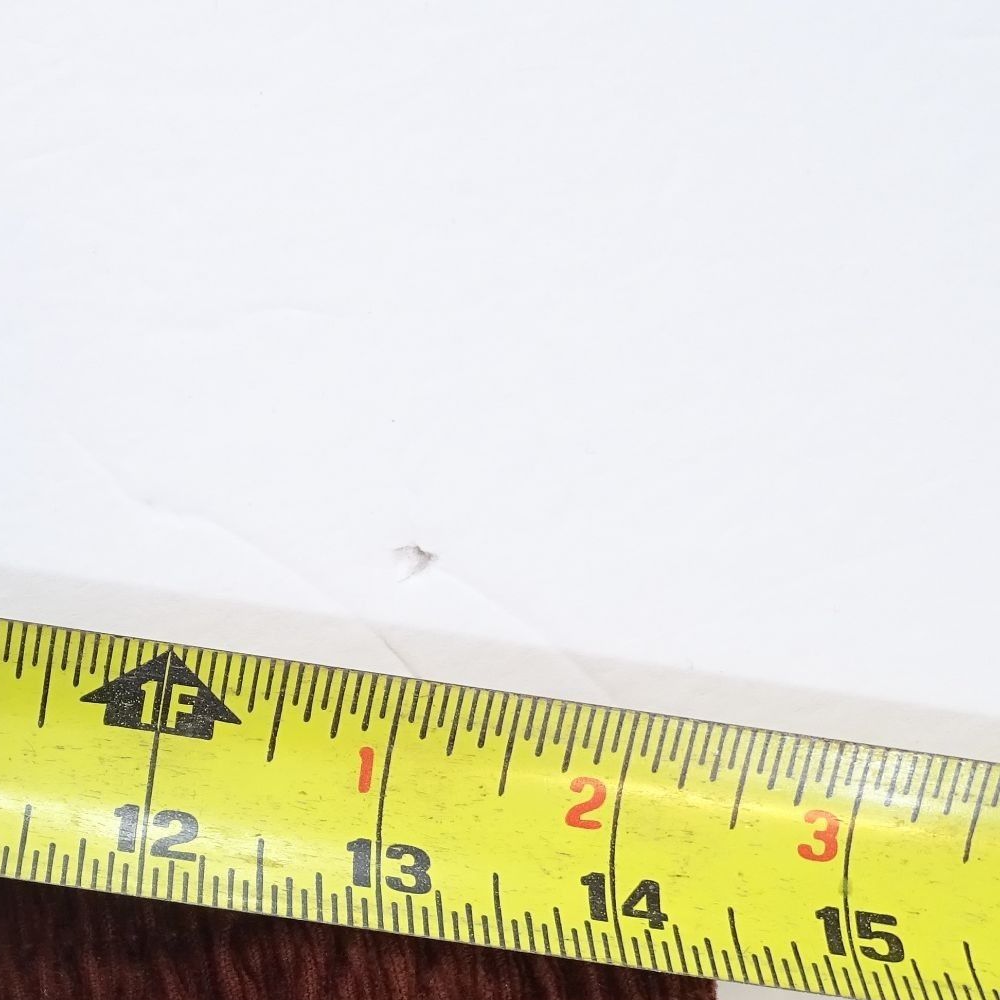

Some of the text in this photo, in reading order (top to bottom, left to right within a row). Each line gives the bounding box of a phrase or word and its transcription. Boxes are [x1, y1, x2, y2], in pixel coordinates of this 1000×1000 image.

[357, 747, 375, 793] 1
[565, 776, 608, 830] 2
[114, 803, 200, 862] 12
[797, 809, 840, 863] 3
[346, 838, 433, 895] 13
[580, 871, 668, 931] 14
[815, 906, 905, 963] 15
